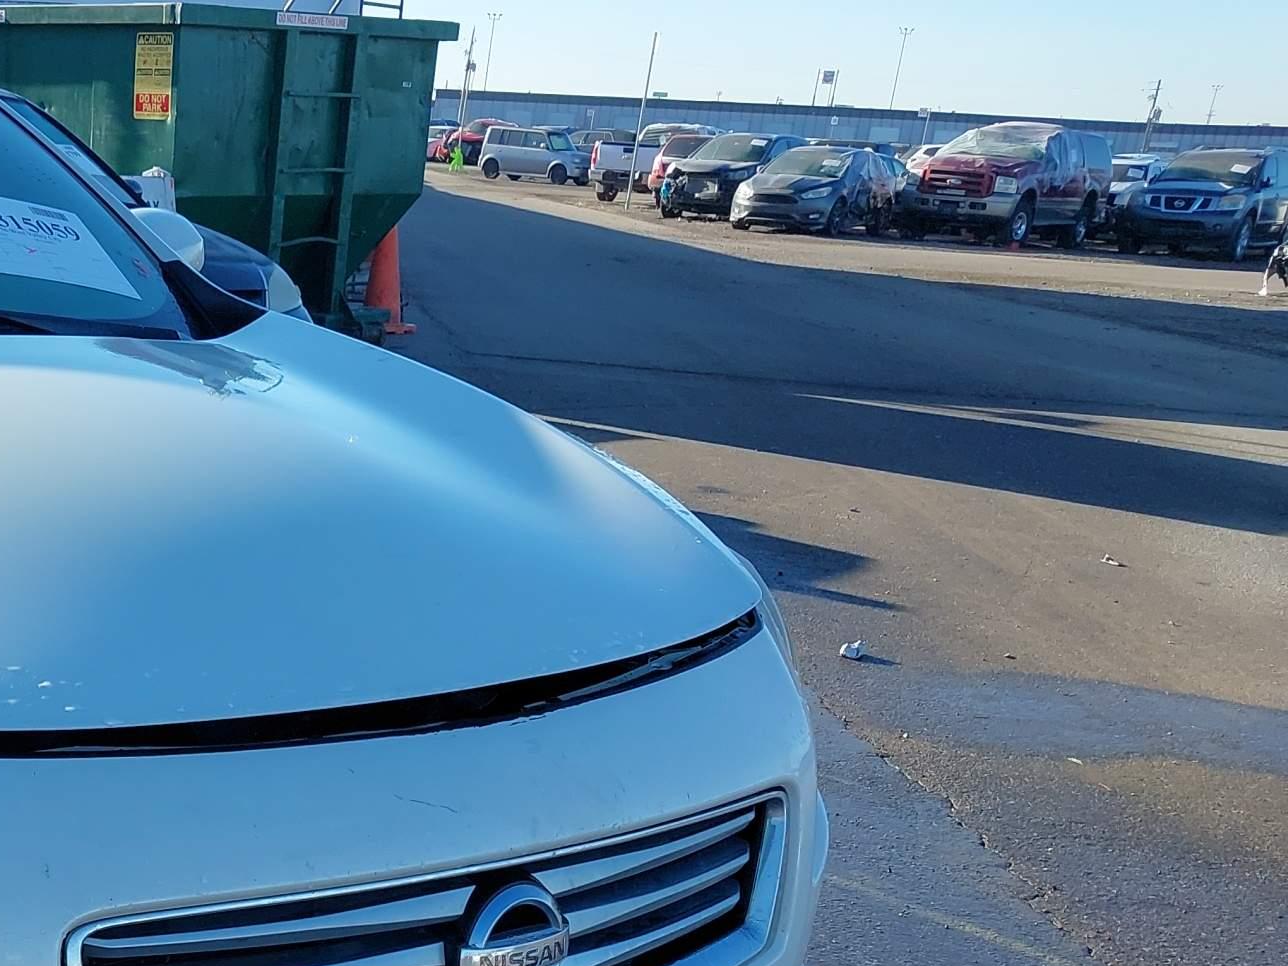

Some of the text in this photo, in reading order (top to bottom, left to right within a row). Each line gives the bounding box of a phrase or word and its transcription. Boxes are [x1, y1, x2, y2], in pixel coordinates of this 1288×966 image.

[144, 35, 172, 45] CAUTION
[139, 94, 167, 103] DO NOT
[143, 103, 163, 112] PARK
